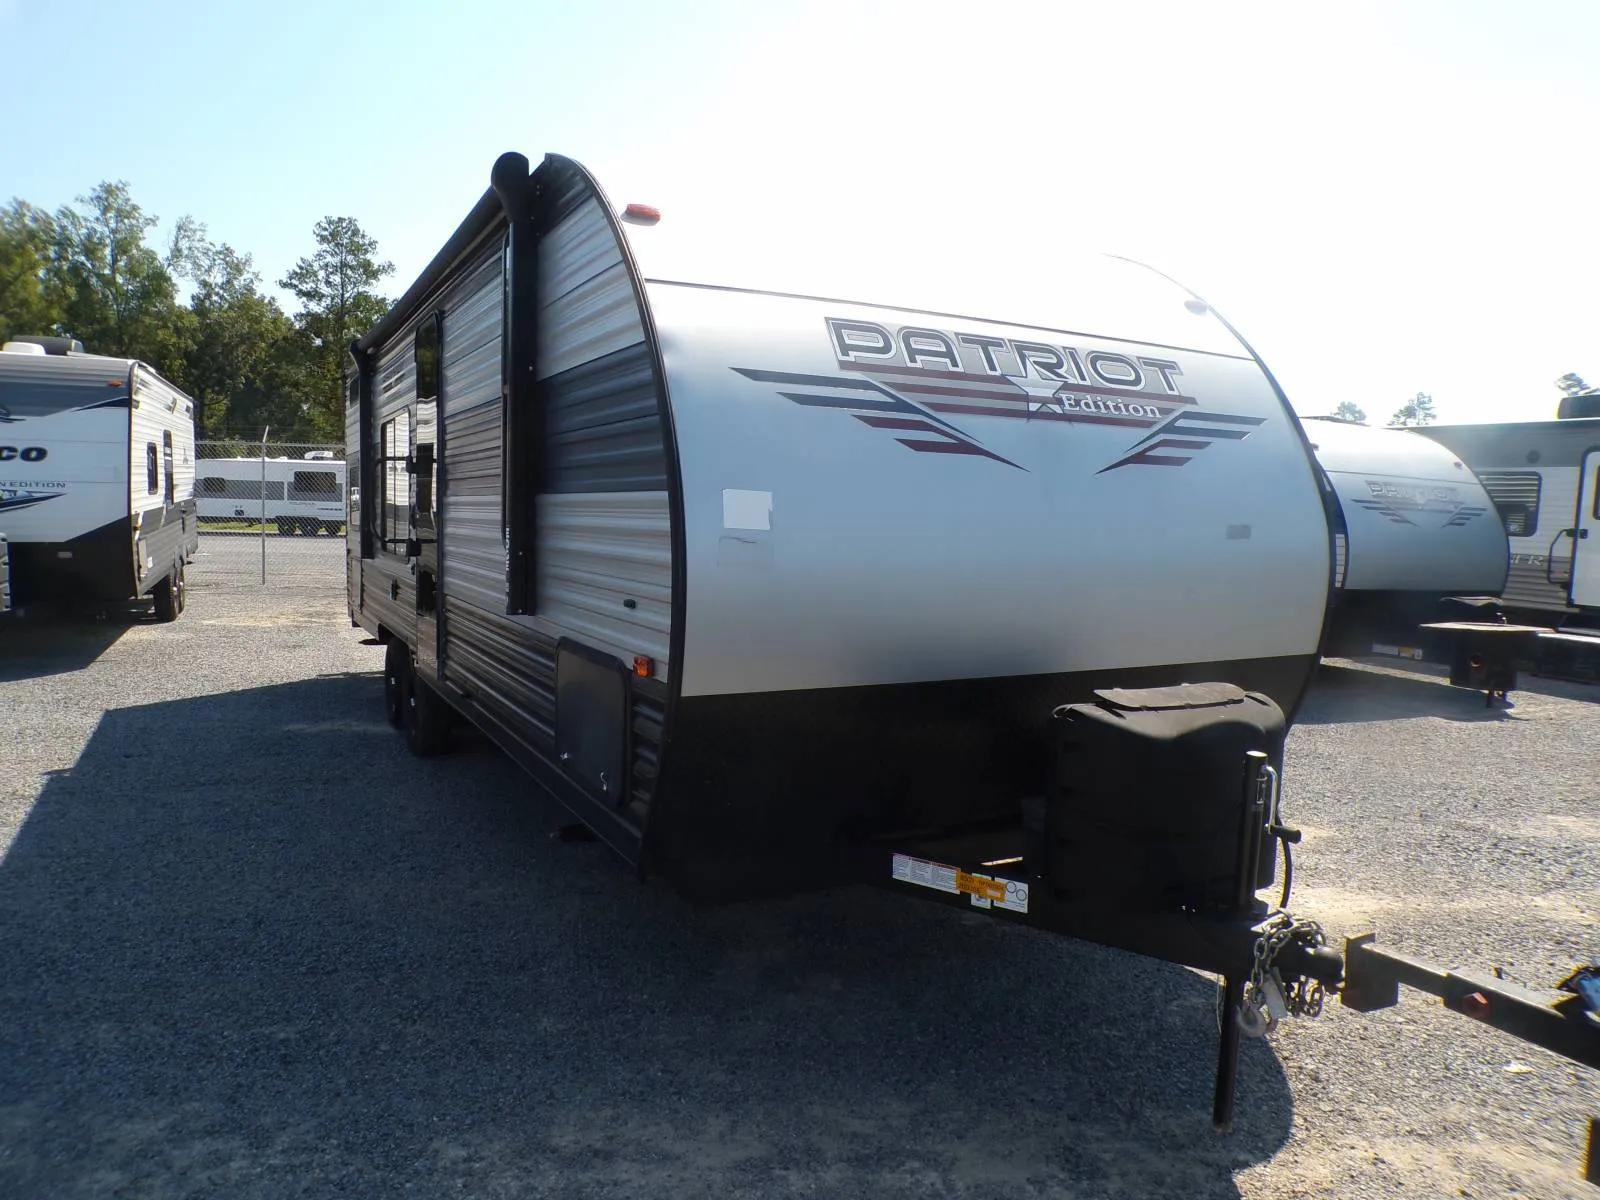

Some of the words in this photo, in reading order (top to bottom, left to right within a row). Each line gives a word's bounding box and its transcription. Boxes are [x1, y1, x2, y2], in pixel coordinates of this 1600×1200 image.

[826, 318, 1183, 396] PATRIOT
[1062, 393, 1162, 418] Edition
[10, 481, 66, 489] EDITION
